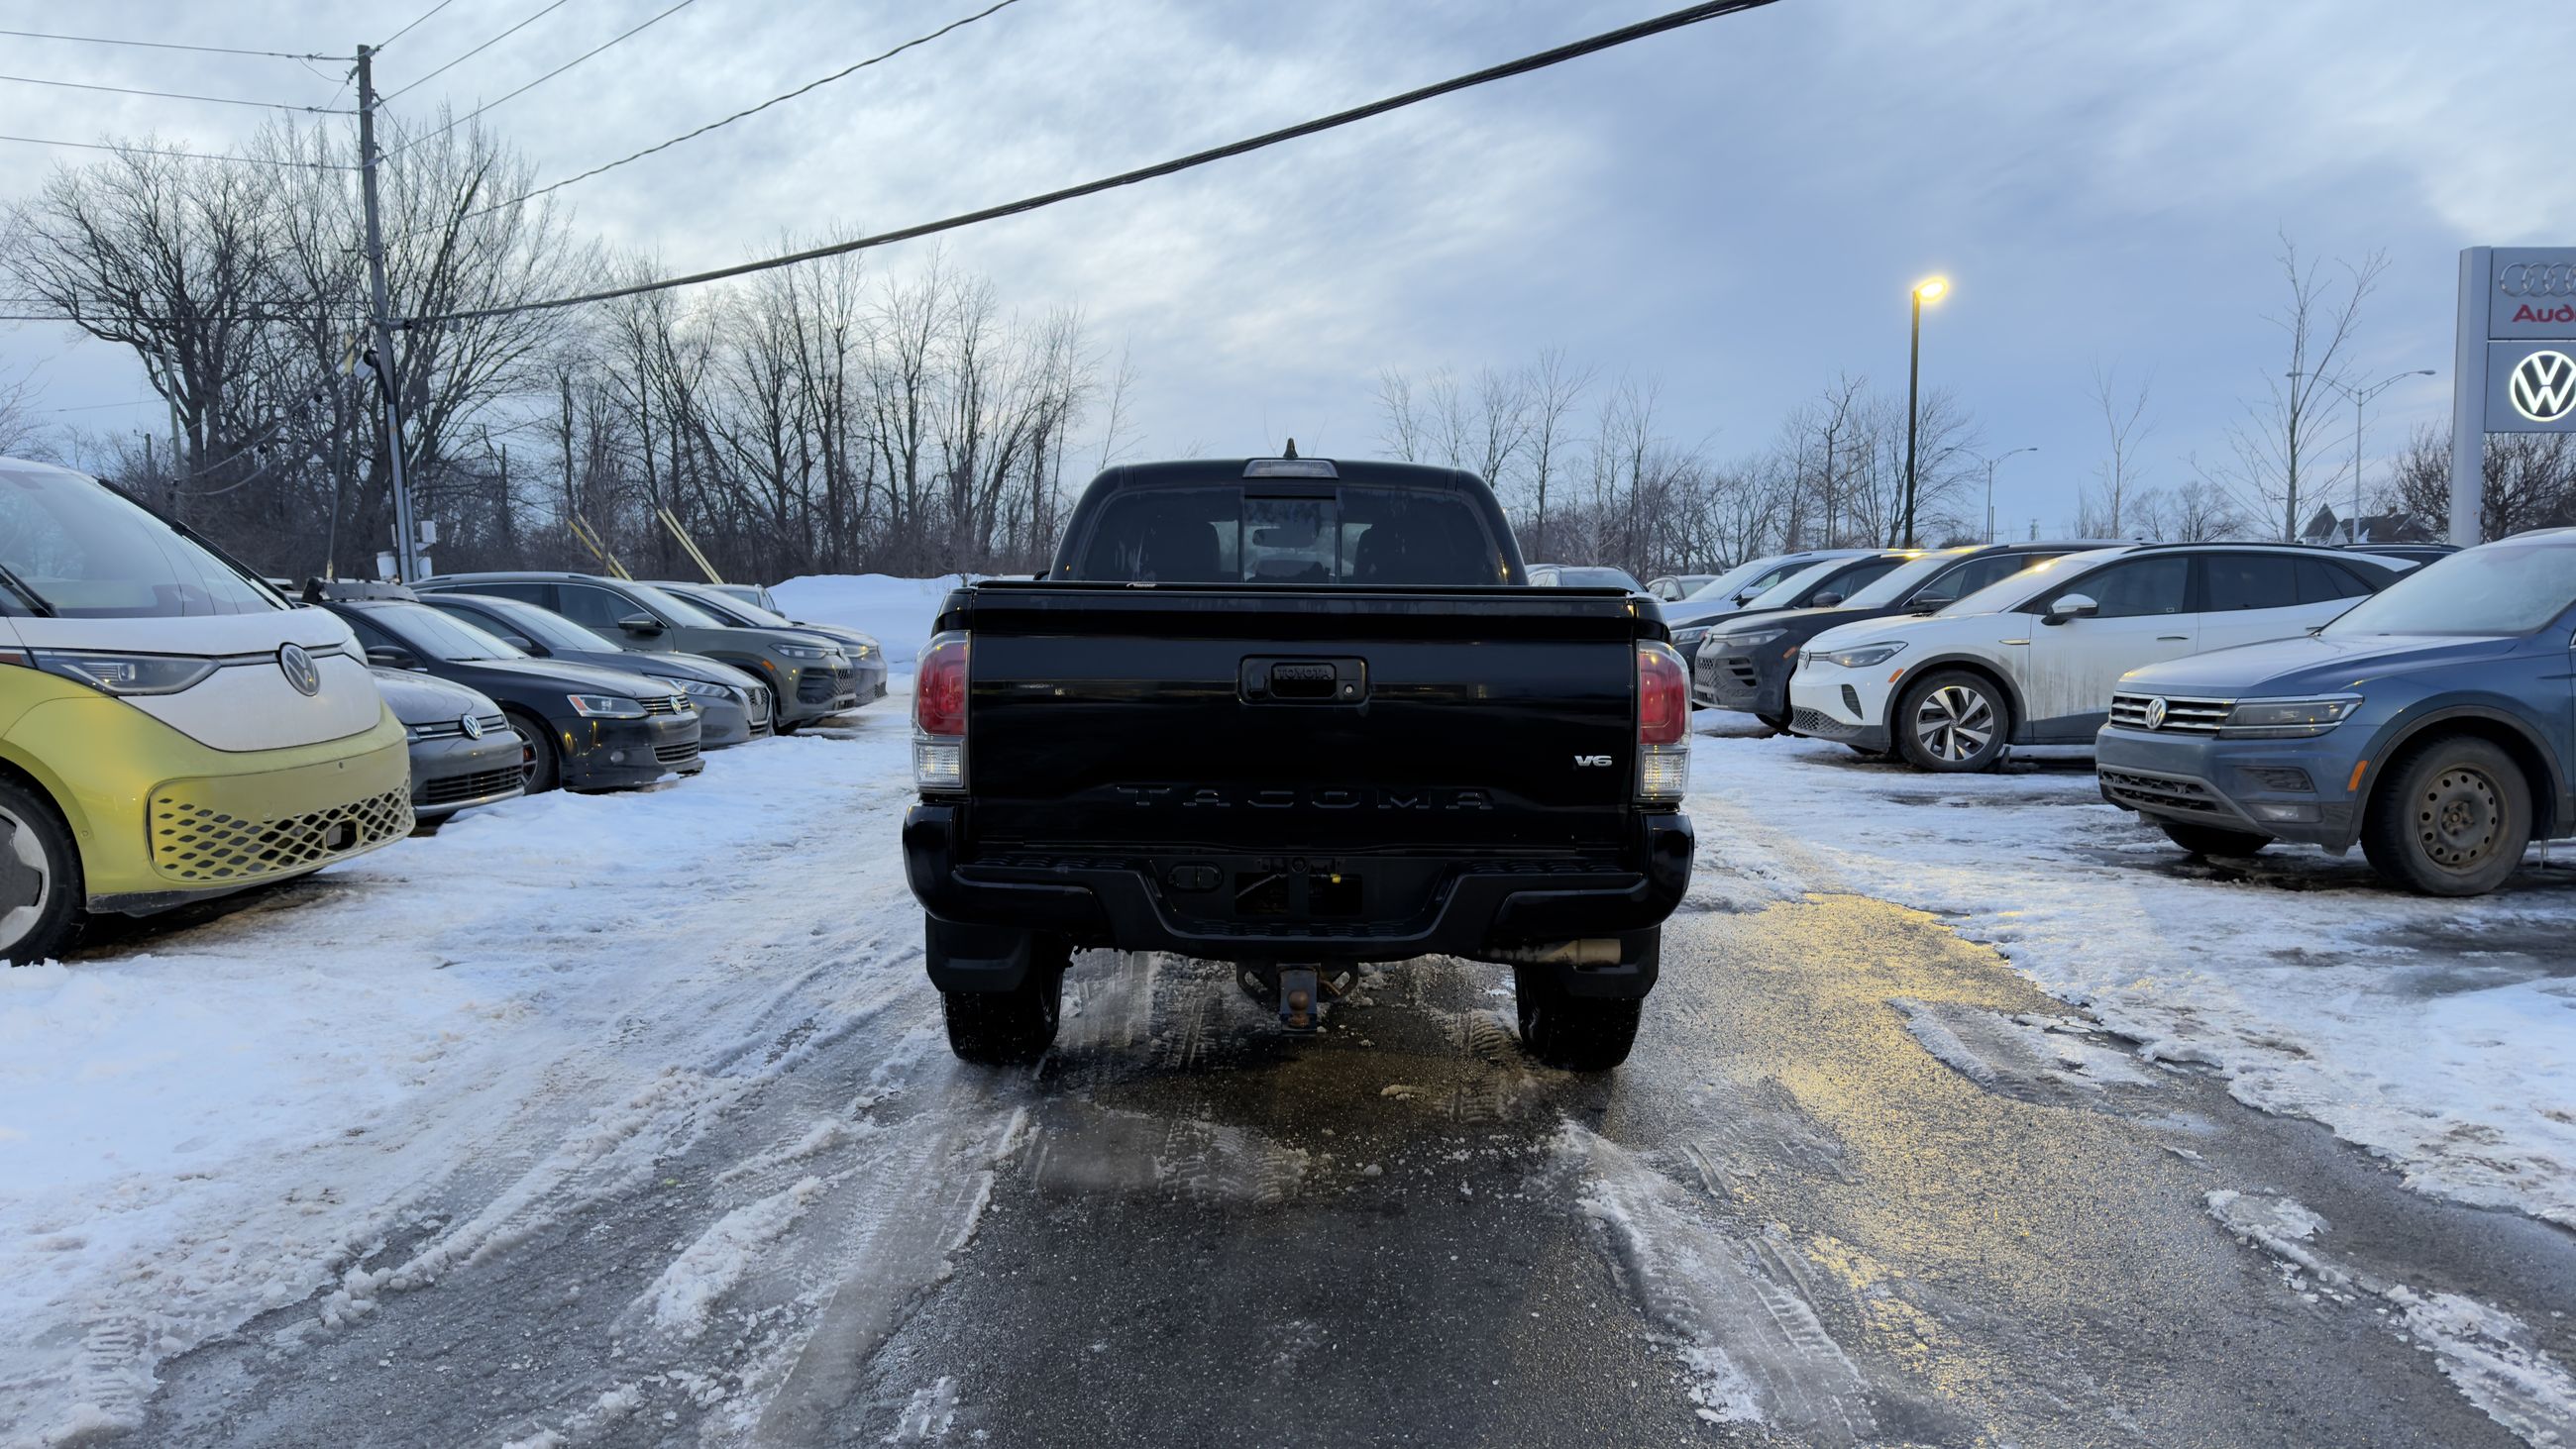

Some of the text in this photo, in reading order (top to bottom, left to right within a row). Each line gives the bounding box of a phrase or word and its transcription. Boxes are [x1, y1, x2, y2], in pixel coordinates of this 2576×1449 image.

[2512, 303, 2576, 323] Aud
[2510, 350, 2576, 422] VW
[1278, 668, 1332, 679] TOYOTA
[1574, 755, 1613, 767] V6
[1116, 783, 1494, 809] TACOMA
